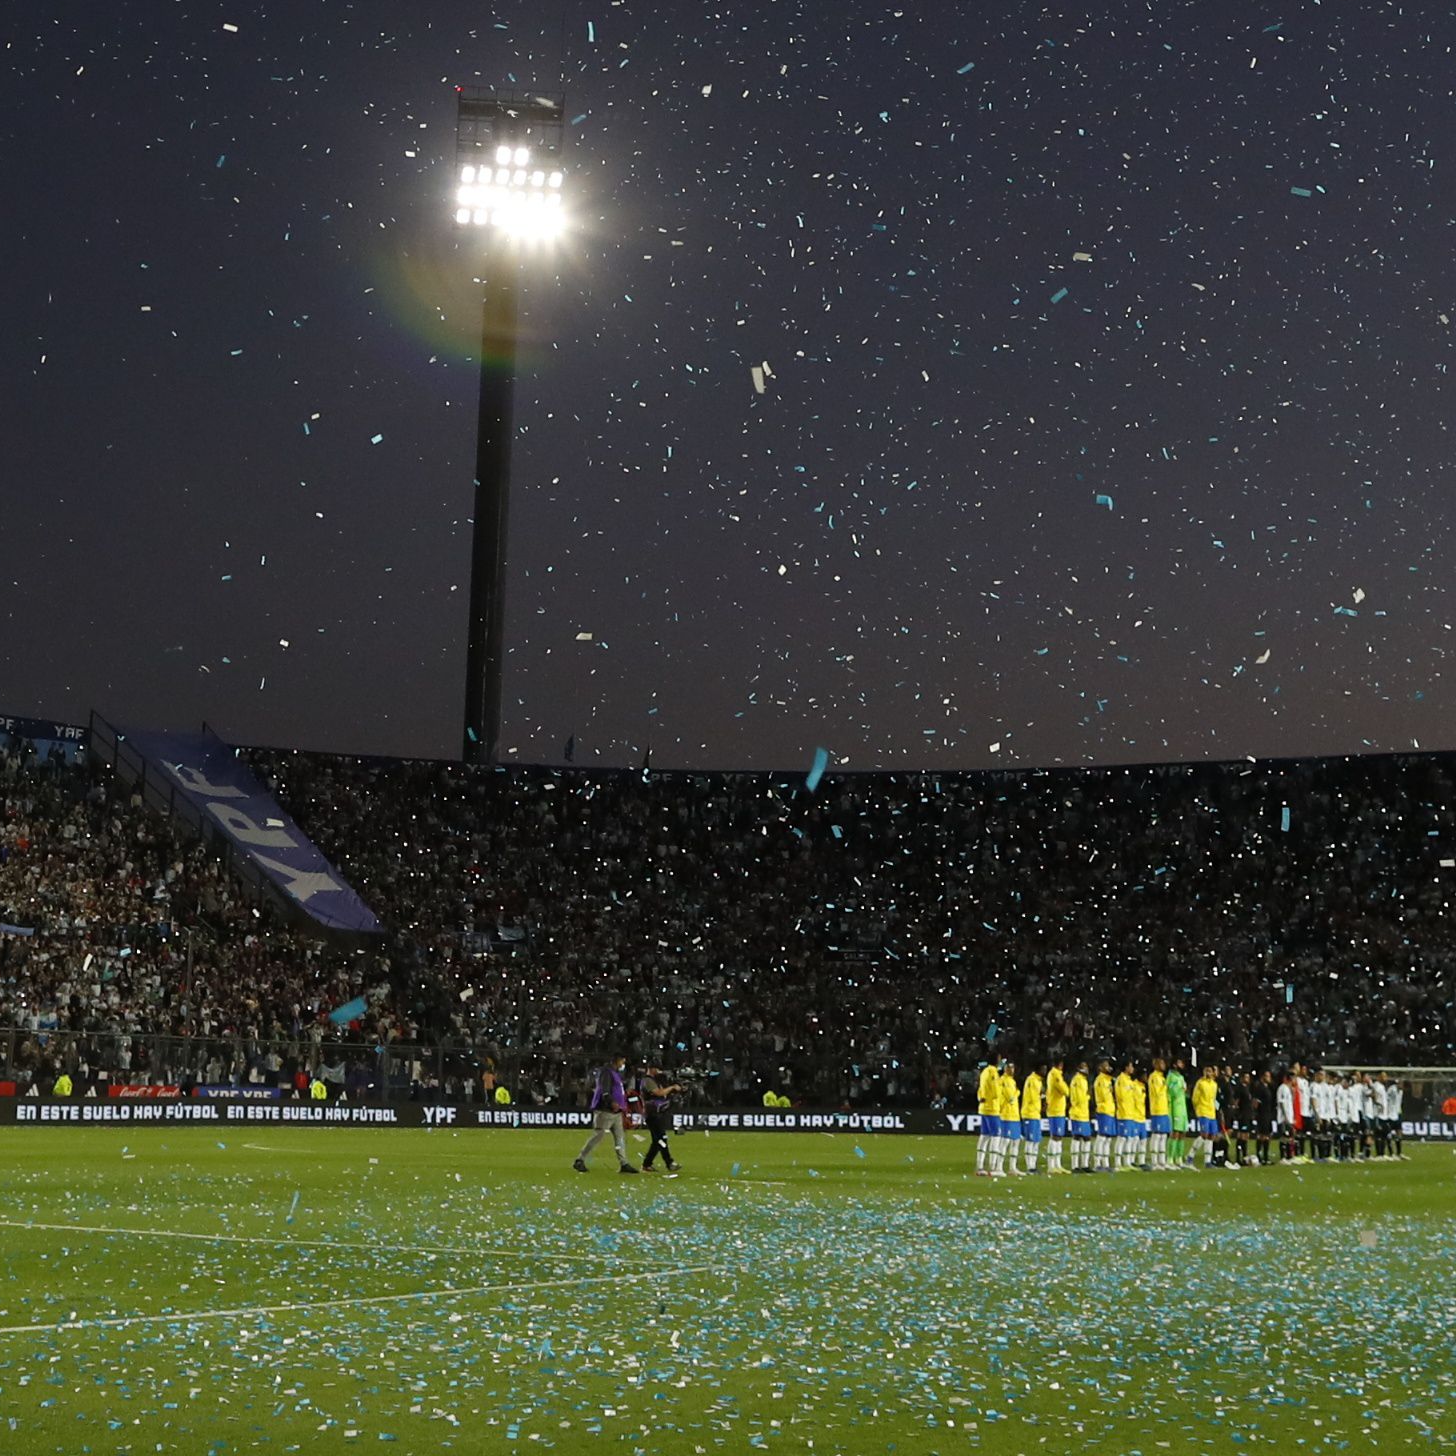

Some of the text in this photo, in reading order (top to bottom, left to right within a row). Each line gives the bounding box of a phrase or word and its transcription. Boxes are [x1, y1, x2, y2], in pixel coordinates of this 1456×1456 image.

[17, 1103, 218, 1120] EN ESTE SUELO HAY FÚTBOL
[227, 1106, 397, 1121] EN ESTE SUELO HAY FÚTBOL
[423, 1107, 456, 1124] YPF
[478, 1111, 591, 1125] EN ESTE SUELO HAY
[744, 1114, 795, 1127] SUELO
[800, 1115, 836, 1128] HAY
[946, 1115, 982, 1131] YP
